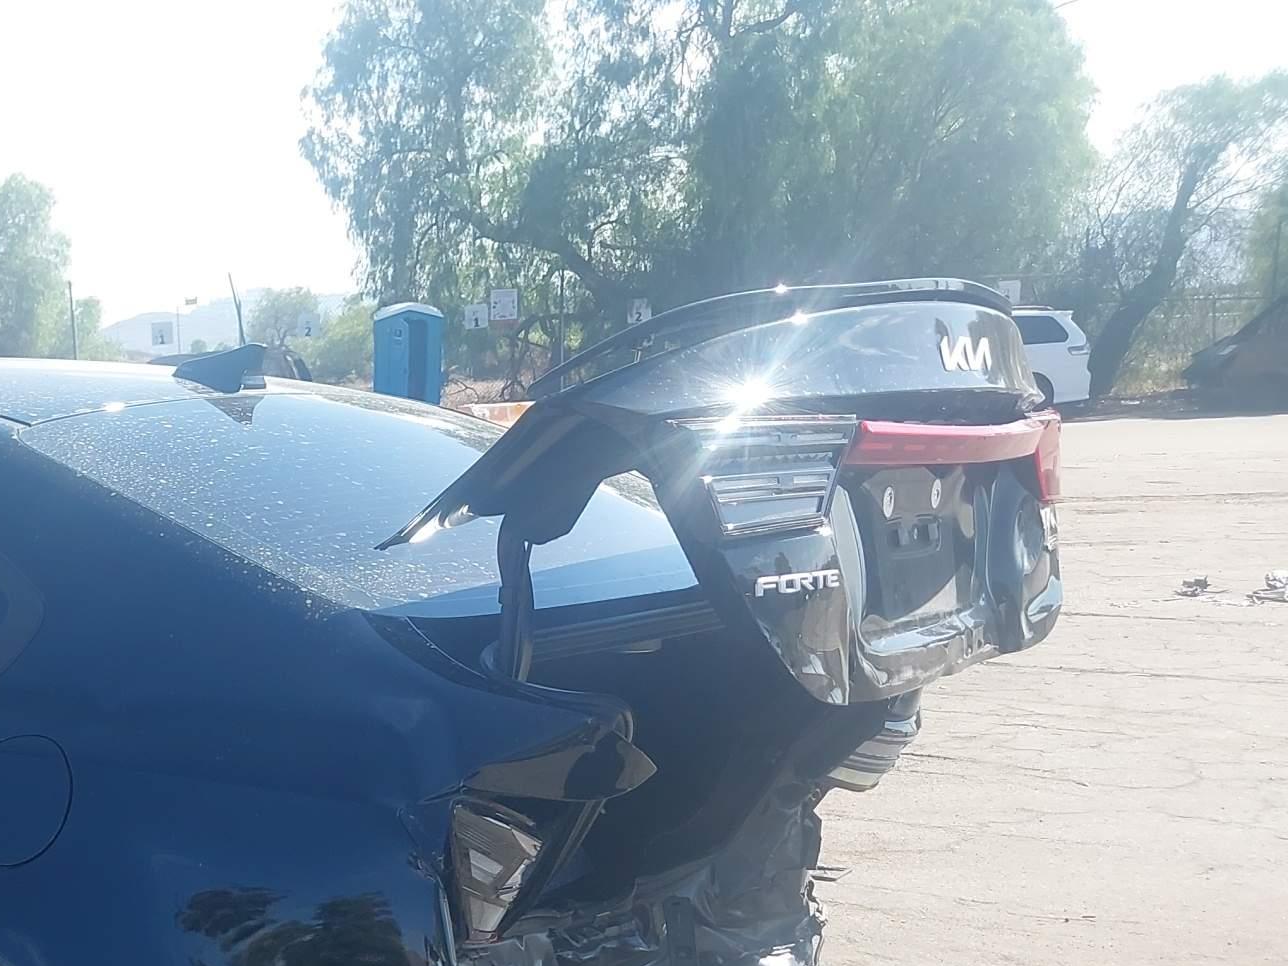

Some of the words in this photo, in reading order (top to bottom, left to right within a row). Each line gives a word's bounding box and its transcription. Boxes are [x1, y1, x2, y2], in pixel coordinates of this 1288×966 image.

[635, 311, 643, 322] 2
[304, 326, 312, 337] 2
[755, 569, 840, 597] FORTE
